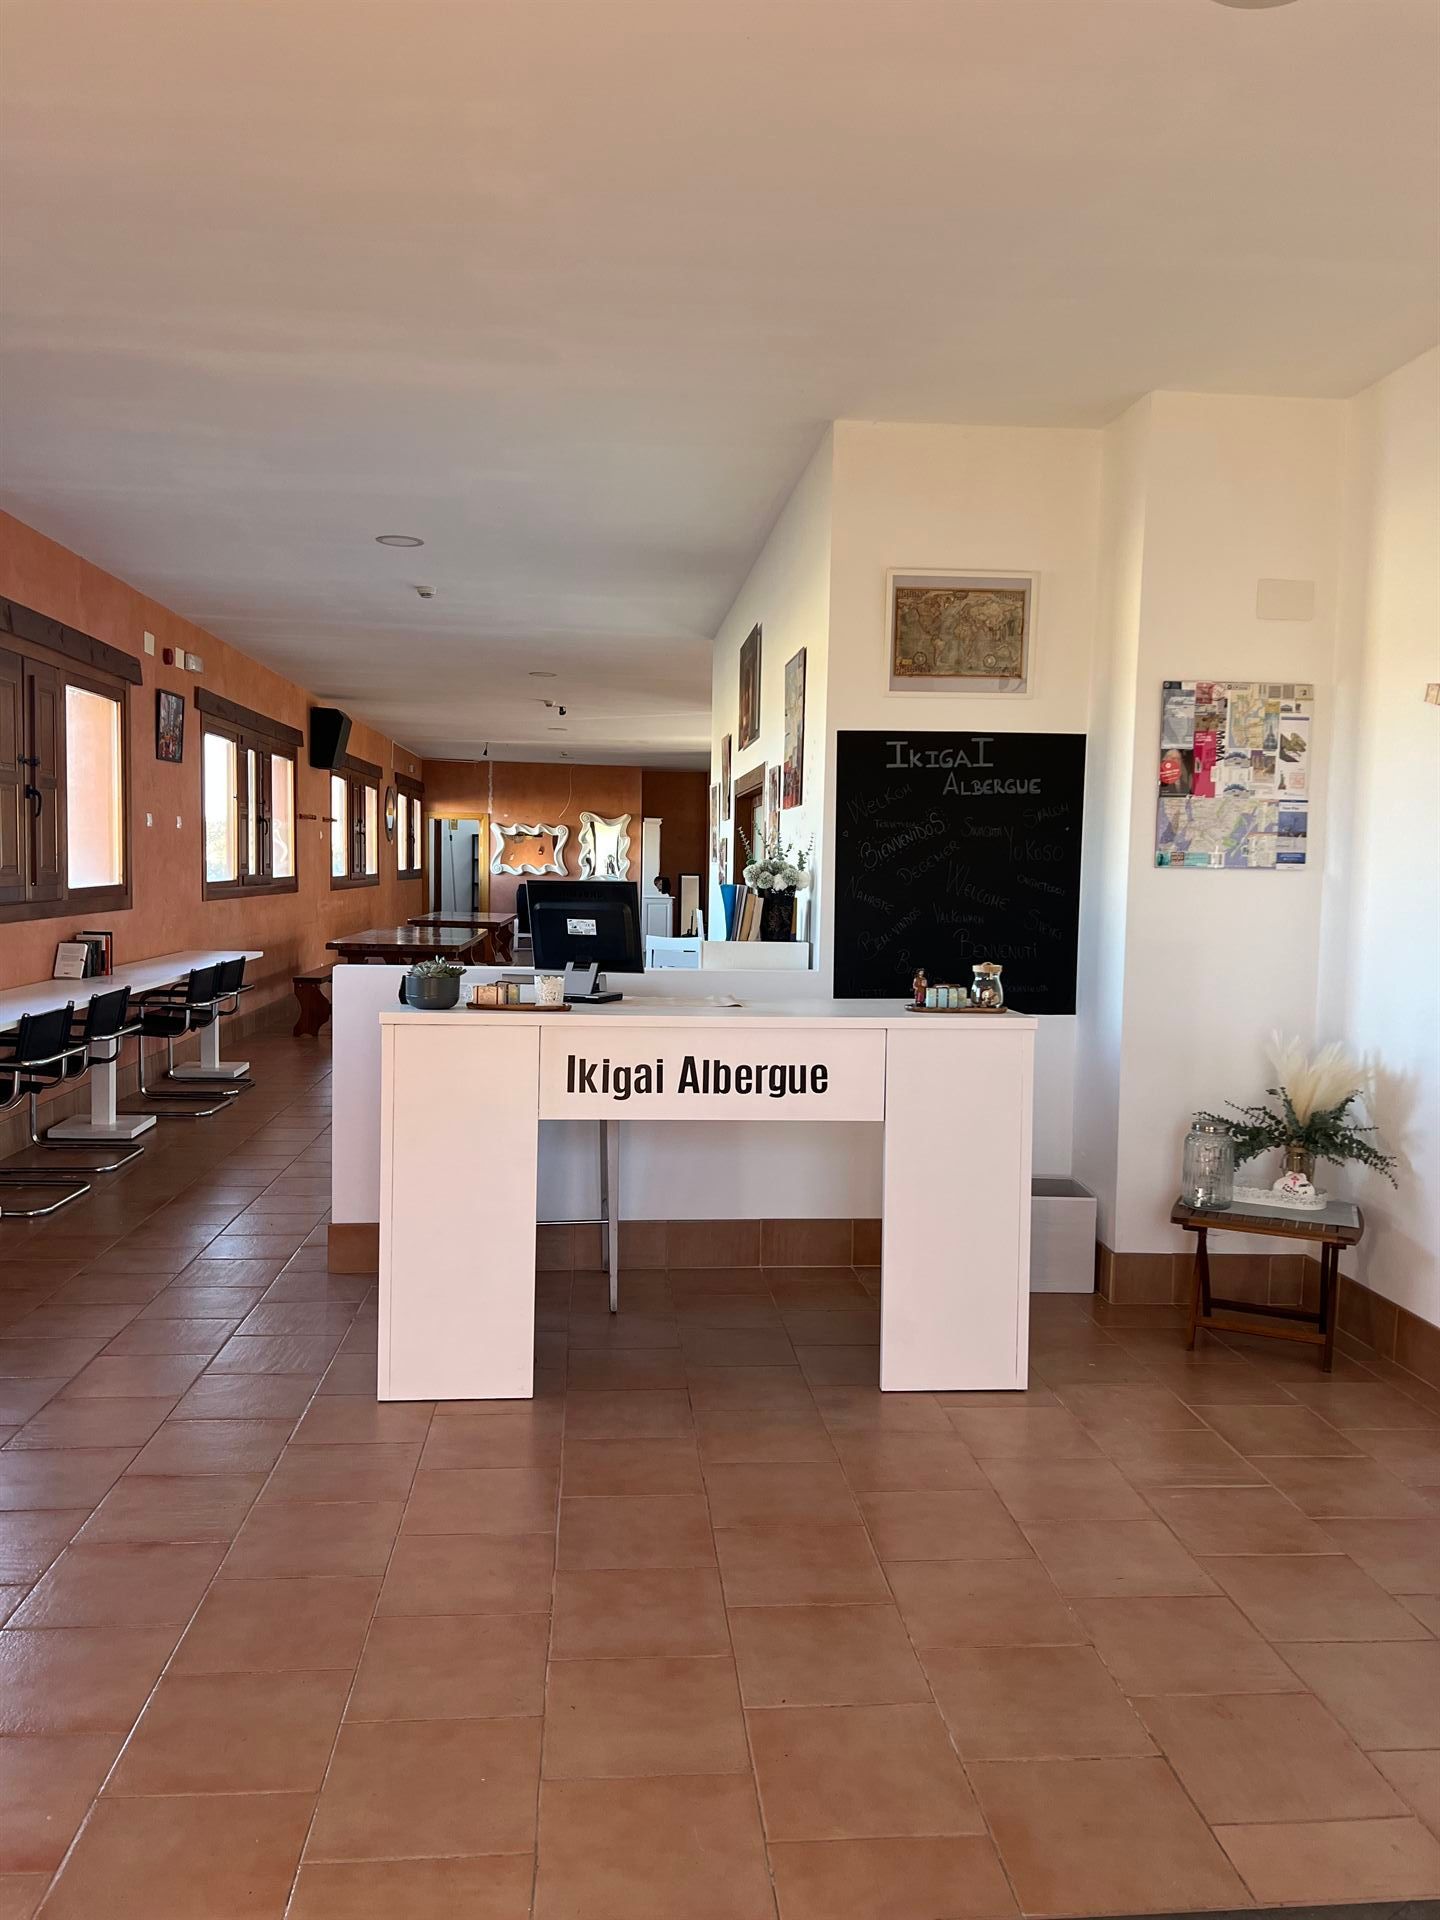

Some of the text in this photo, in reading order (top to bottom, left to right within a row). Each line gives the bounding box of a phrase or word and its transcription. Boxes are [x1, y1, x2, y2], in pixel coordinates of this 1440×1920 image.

[942, 771, 1042, 796] ALBERGUE
[860, 812, 946, 869] BIENVENIDOS
[566, 1054, 830, 1101] Ikigai Albergue
